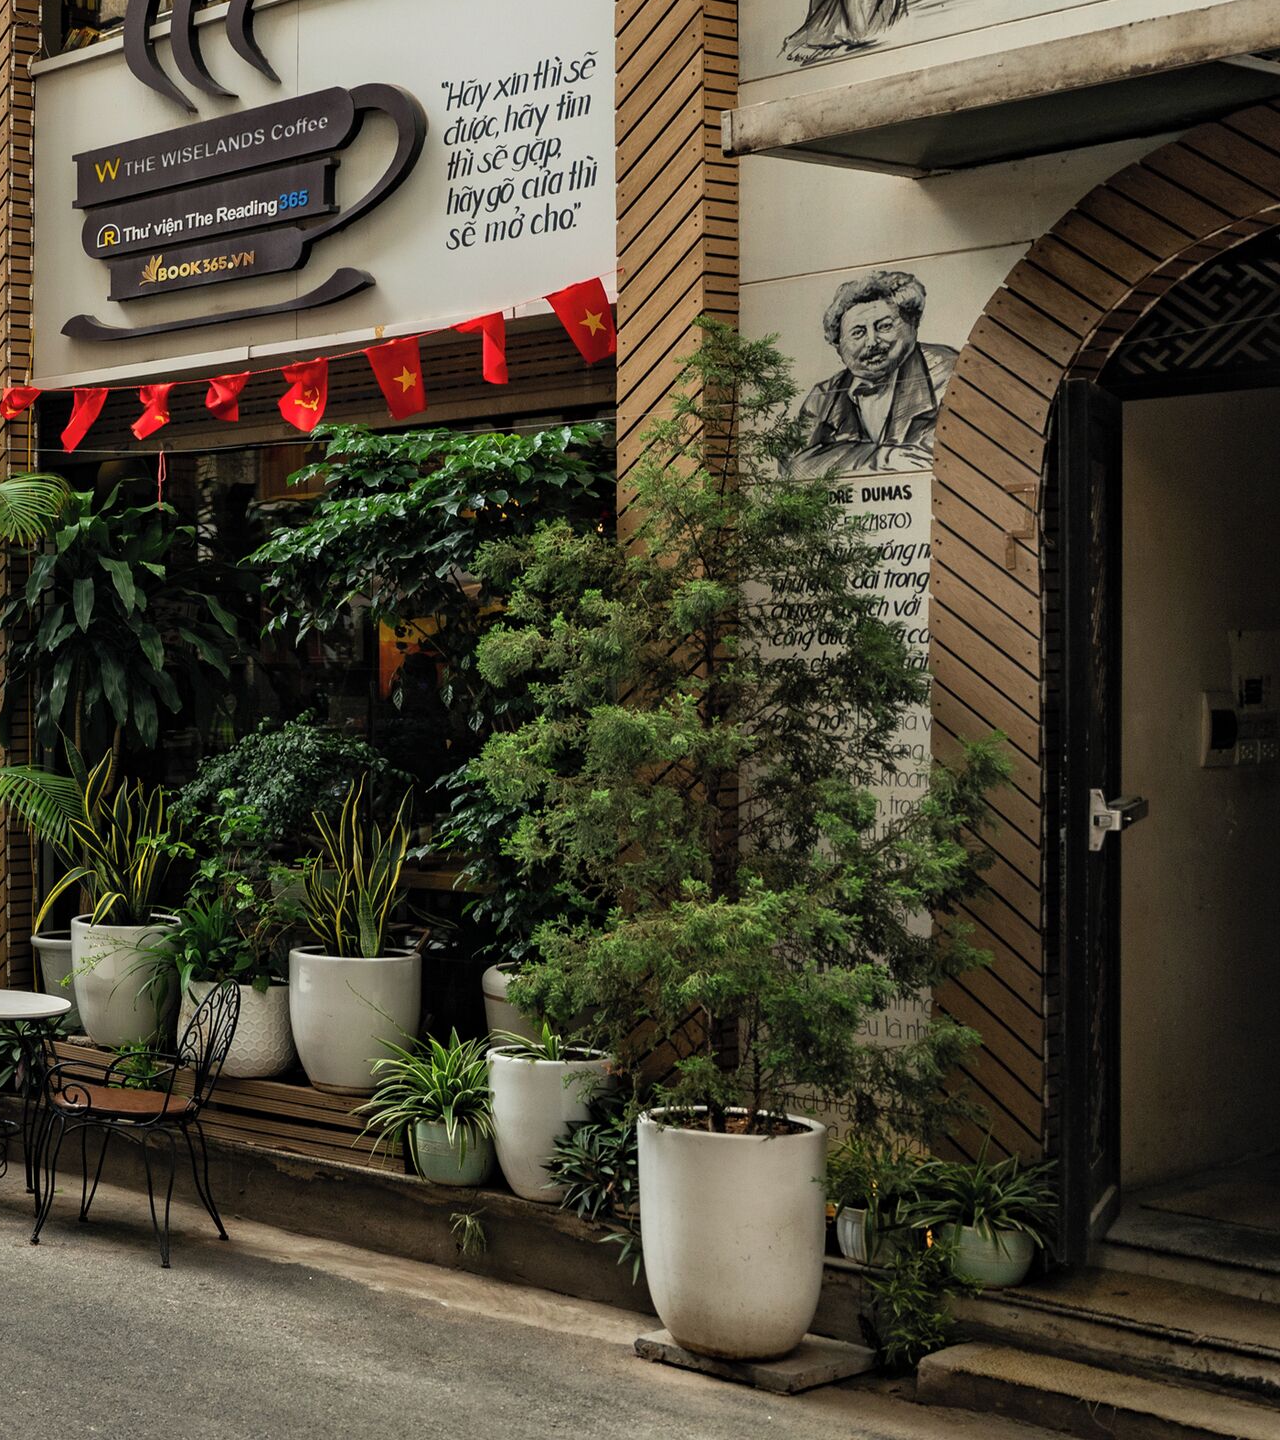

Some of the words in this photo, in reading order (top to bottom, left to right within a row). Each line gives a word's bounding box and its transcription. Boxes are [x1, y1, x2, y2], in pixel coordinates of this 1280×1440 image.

[493, 72, 529, 101] xin
[533, 56, 562, 90] thì
[564, 50, 599, 84] sẽ
[504, 103, 549, 137] hãy
[556, 91, 591, 122] tìm
[94, 158, 121, 184] W
[124, 156, 157, 178] THE
[161, 129, 266, 168] WISELANDS
[270, 115, 329, 141] Coffee
[447, 148, 474, 181] thì
[477, 145, 508, 174] sẽ
[447, 186, 485, 219] hãy
[487, 176, 515, 213] gõ
[568, 155, 598, 190] thì
[123, 222, 152, 243] Thư
[154, 217, 182, 238] viện
[185, 211, 213, 230] The
[446, 221, 477, 250] sẽ
[485, 206, 525, 243] mở
[862, 484, 912, 502] DUMAS
[894, 594, 922, 617] với
